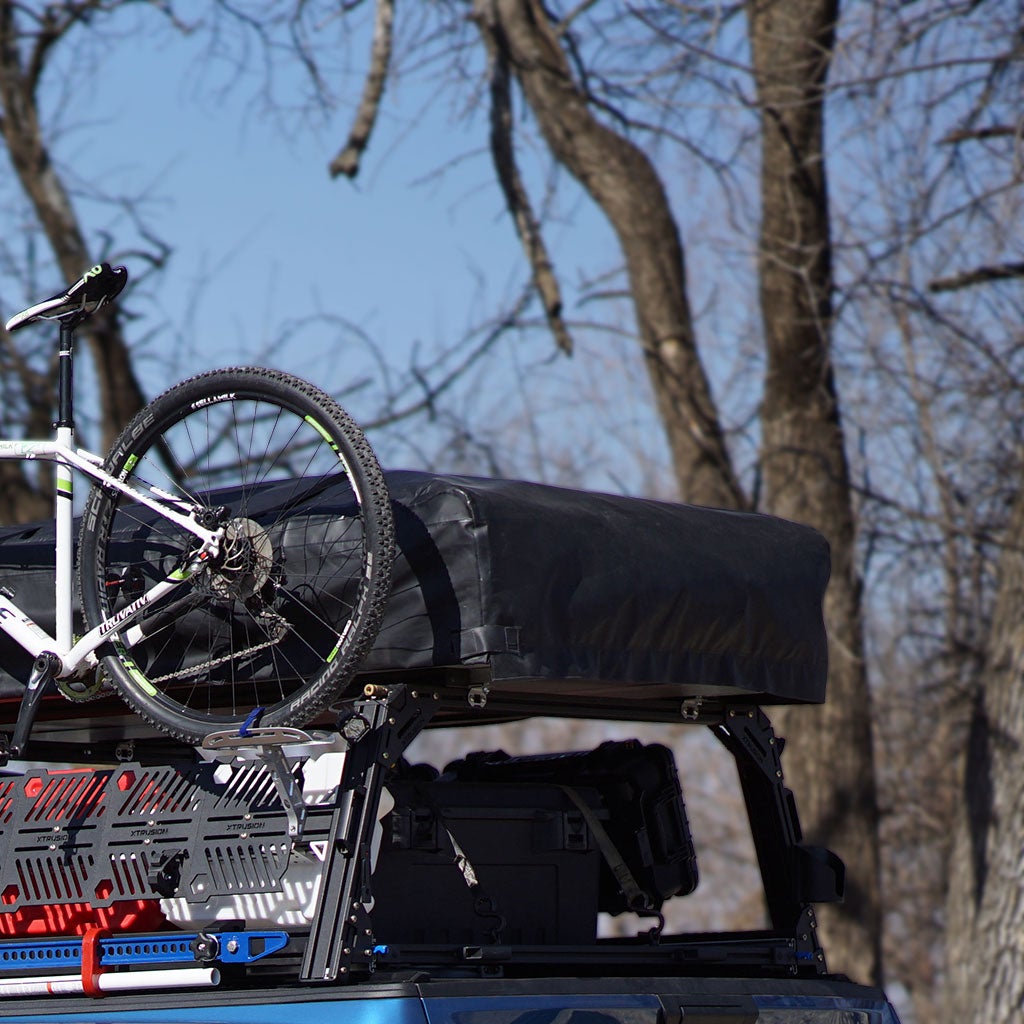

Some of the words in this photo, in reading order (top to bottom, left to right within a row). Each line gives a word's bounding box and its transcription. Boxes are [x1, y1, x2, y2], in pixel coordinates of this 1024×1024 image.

[86, 413, 156, 533] SCALBE
[226, 821, 266, 831] XTRUSION
[130, 827, 169, 837] XTRUSION
[36, 834, 74, 844] XTRUSION
